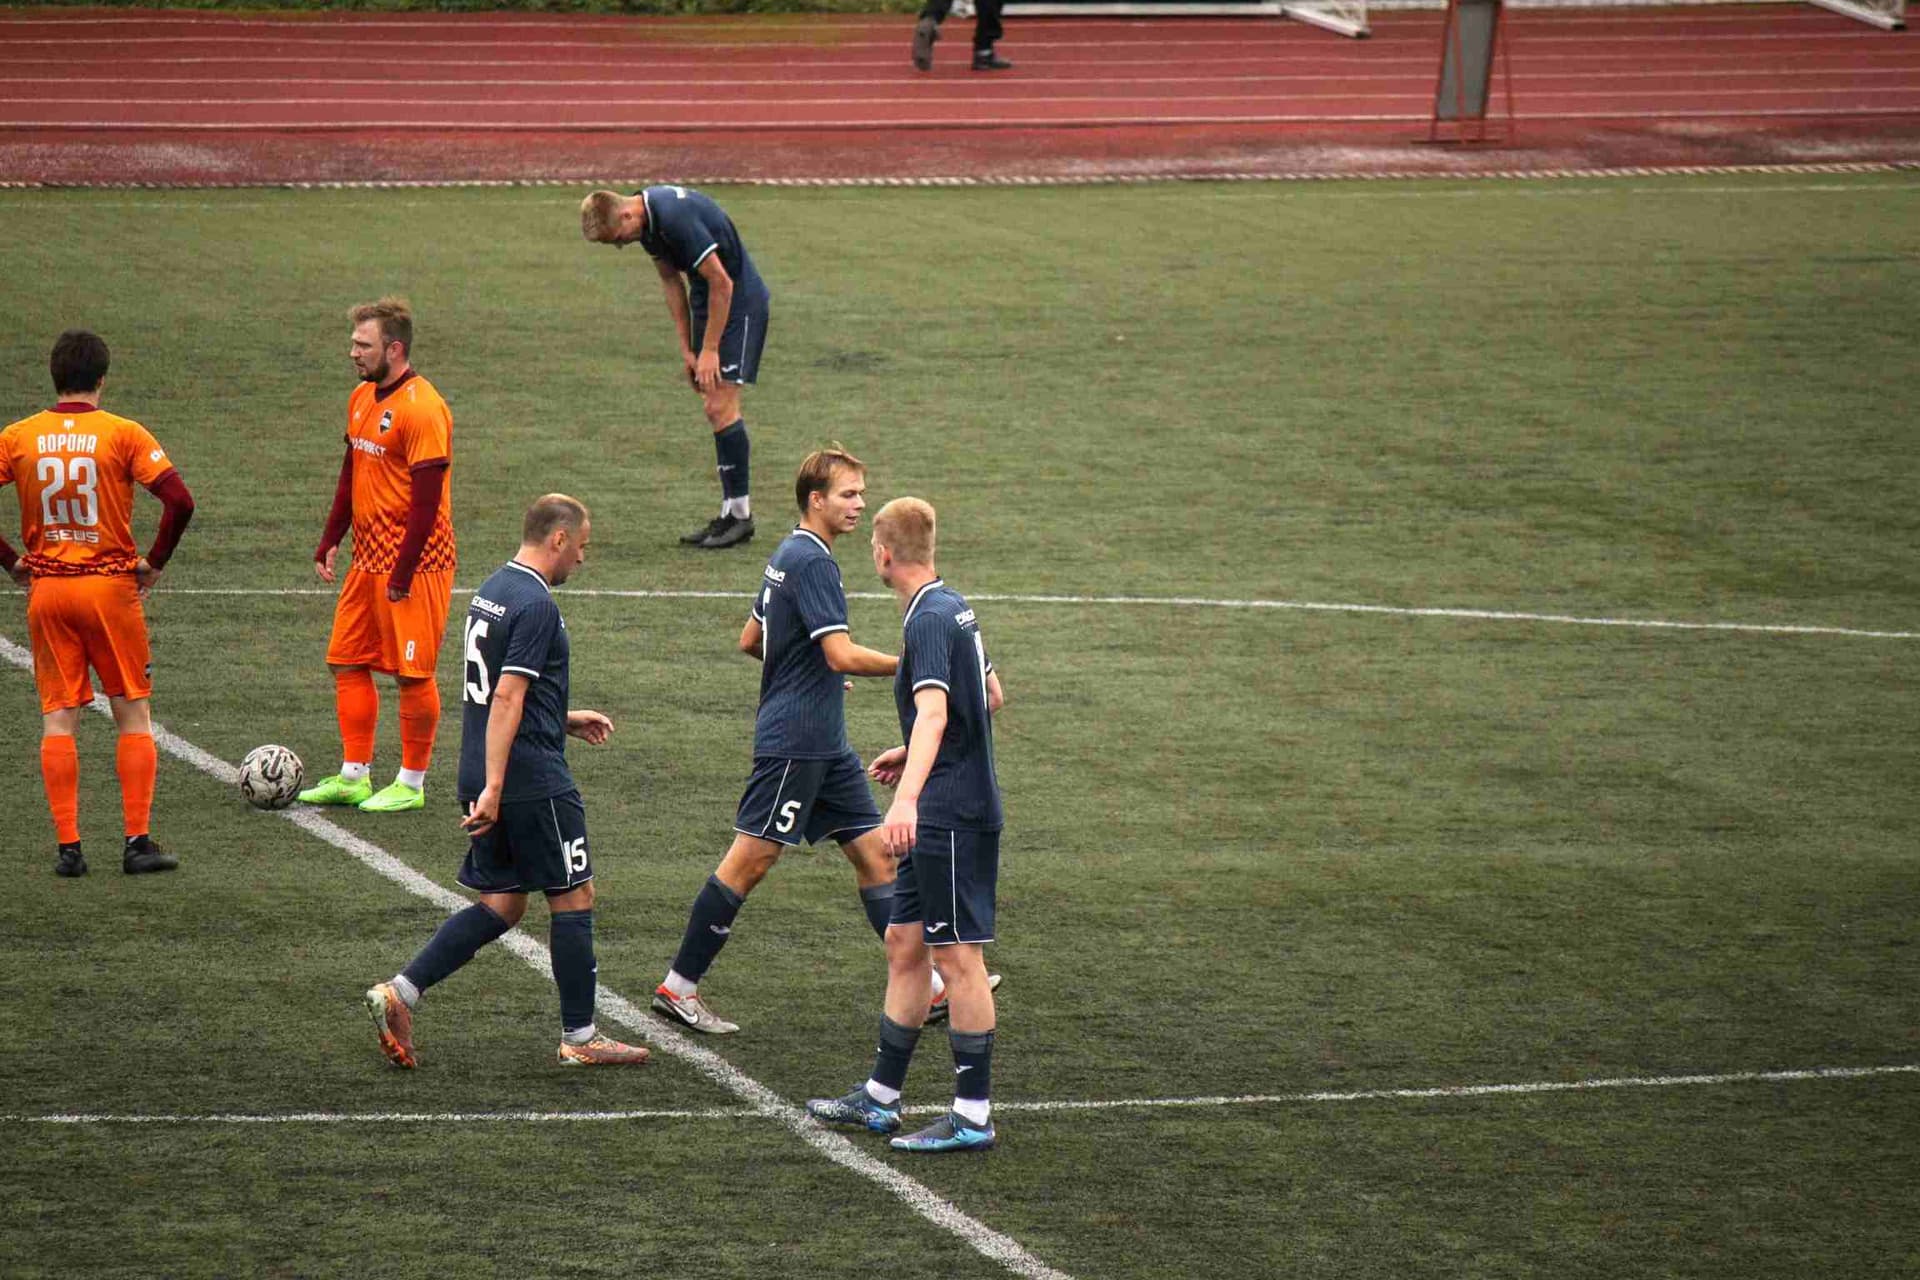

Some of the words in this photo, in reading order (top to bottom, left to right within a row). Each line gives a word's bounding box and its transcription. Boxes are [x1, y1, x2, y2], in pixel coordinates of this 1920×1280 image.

[37, 434, 97, 453] ВОРОНА
[37, 457, 99, 526] 23
[405, 640, 415, 661] 8
[776, 800, 801, 833] 5
[564, 837, 587, 874] 15
